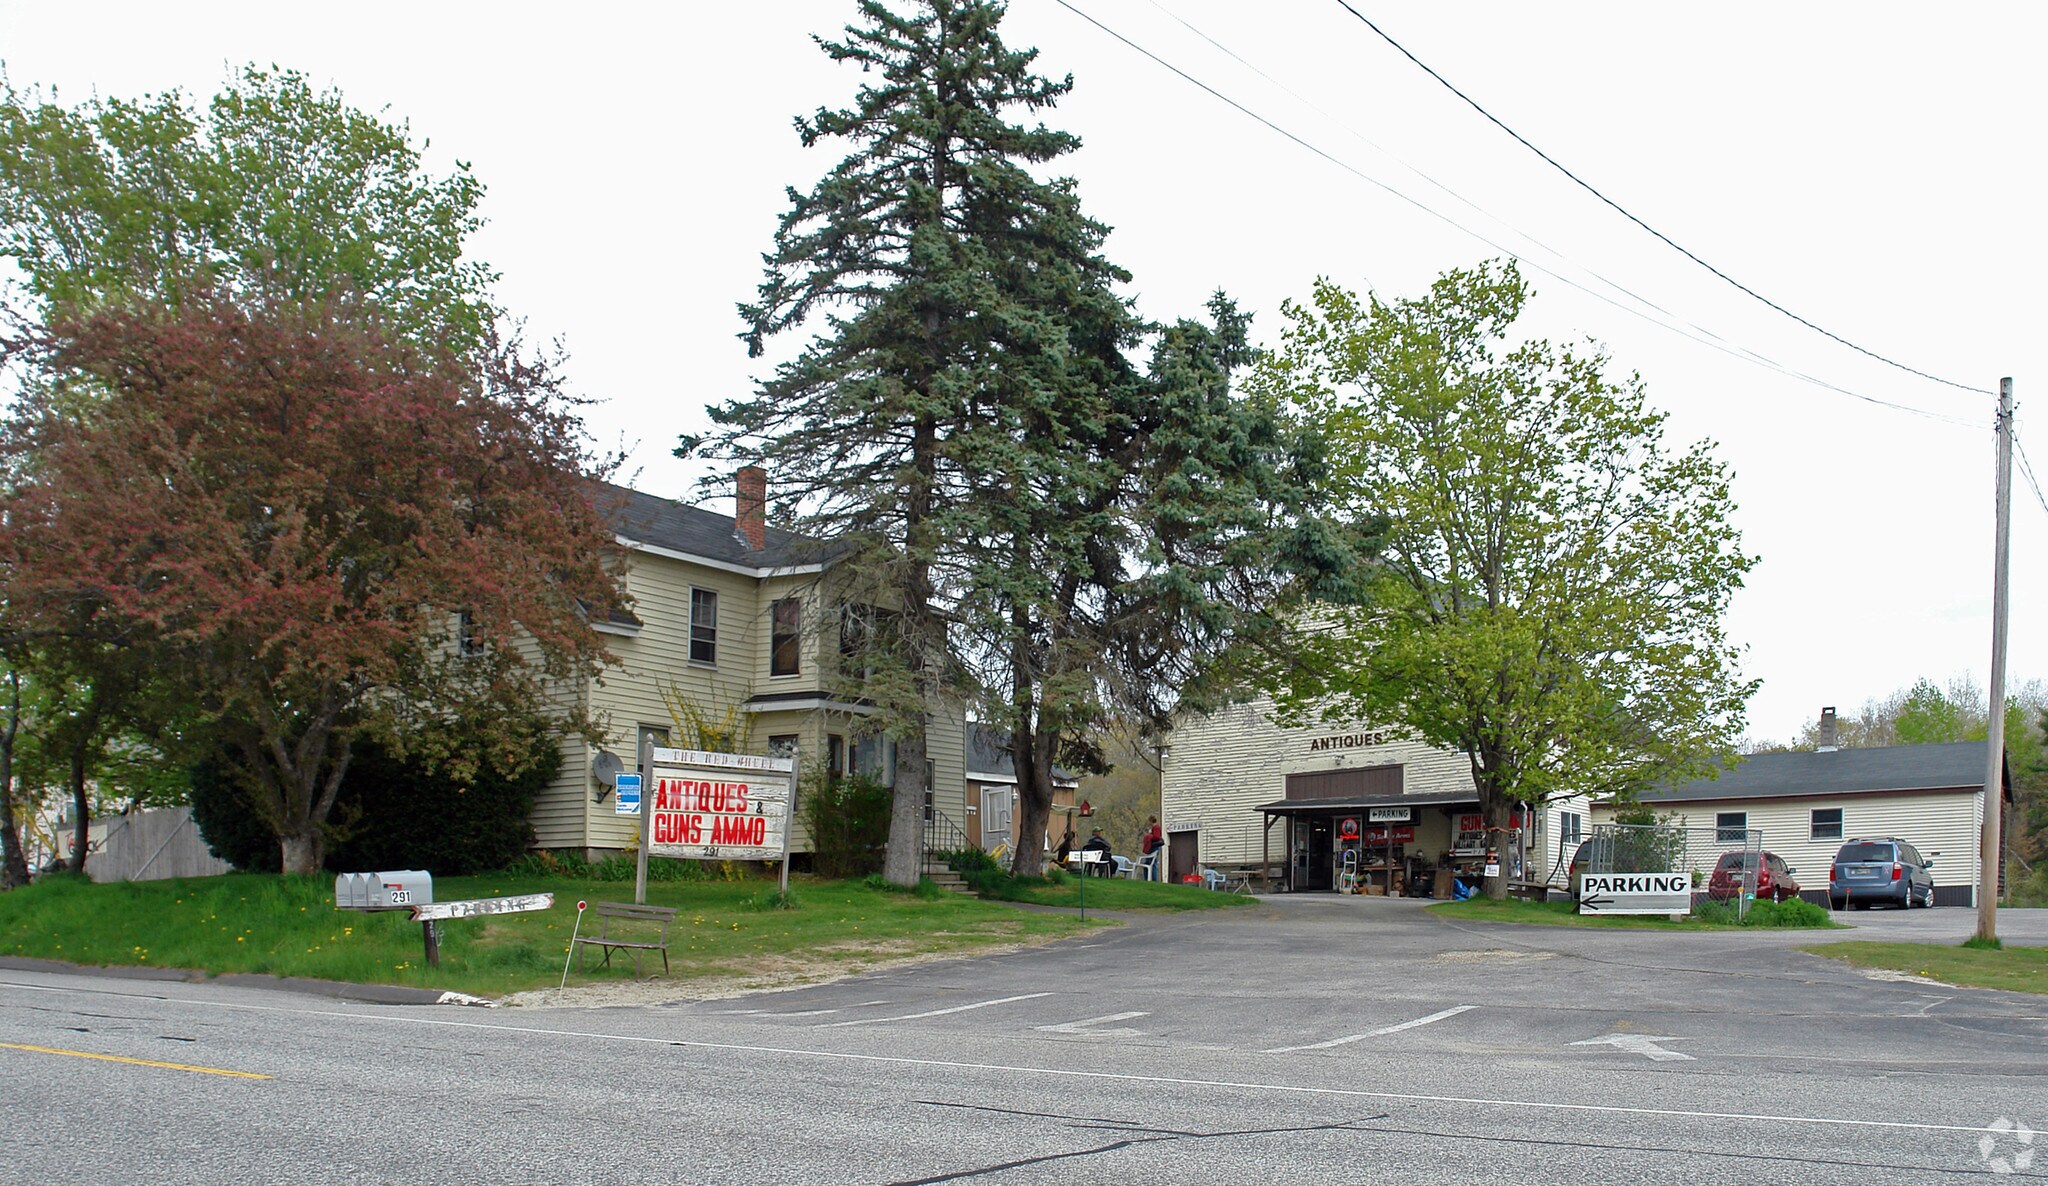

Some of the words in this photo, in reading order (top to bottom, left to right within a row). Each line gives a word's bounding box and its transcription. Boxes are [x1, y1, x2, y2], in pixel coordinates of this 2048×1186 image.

[1311, 732, 1383, 750] ANTIQUES
[672, 751, 697, 762] THE
[704, 754, 728, 765] RED
[656, 779, 748, 813] ANTIQUES
[755, 801, 763, 814] &
[1378, 809, 1408, 819] PARKING
[654, 813, 702, 844] GUNS
[710, 815, 765, 845] AMMO
[703, 846, 719, 857] 291
[1584, 876, 1687, 892] PARKING
[392, 891, 410, 903] 291
